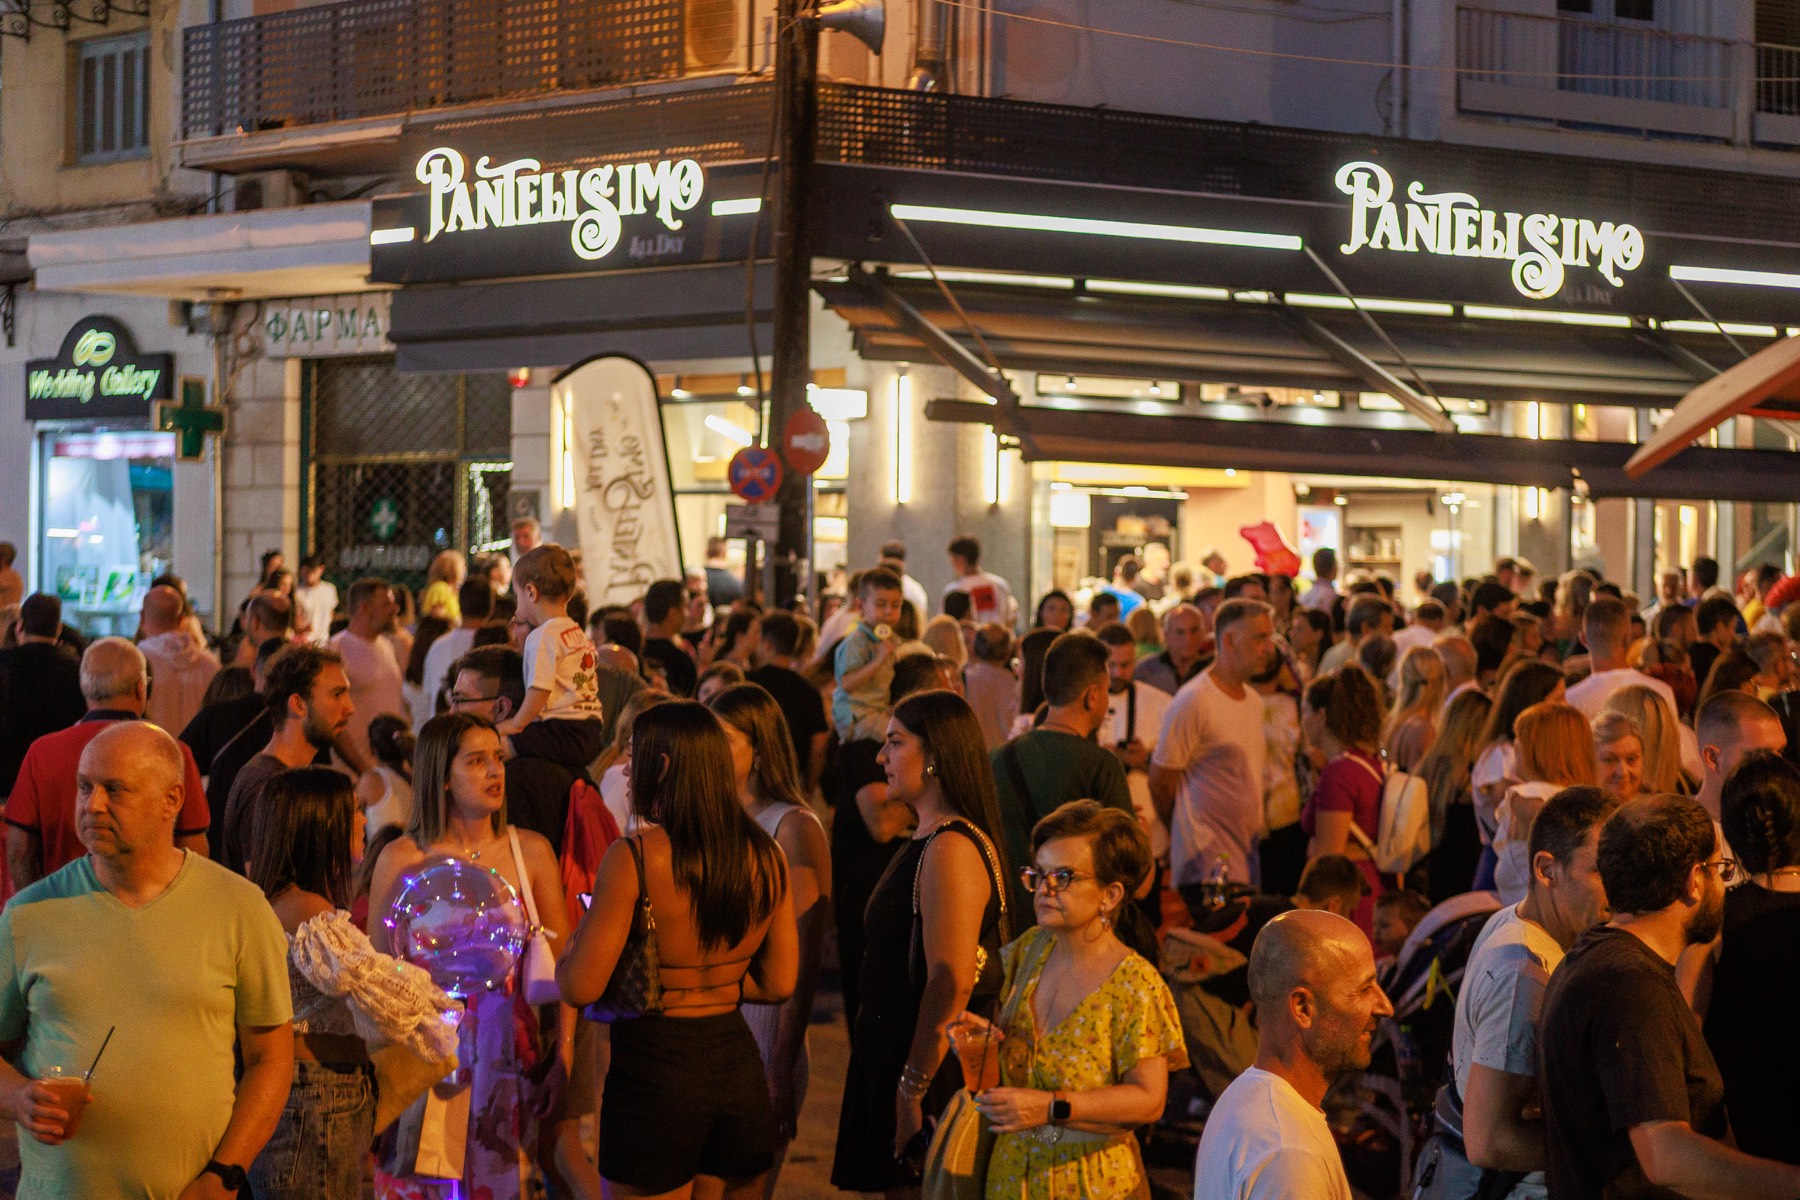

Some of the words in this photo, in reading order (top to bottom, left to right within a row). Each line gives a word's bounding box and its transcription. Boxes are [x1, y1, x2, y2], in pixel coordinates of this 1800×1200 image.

[416, 147, 704, 260] PANTELISIMO
[1335, 161, 1644, 299] PANTELISIMO
[265, 305, 381, 342] ΦΑΡΜΑ
[29, 368, 96, 404] Wedding
[99, 364, 160, 400] Gallery
